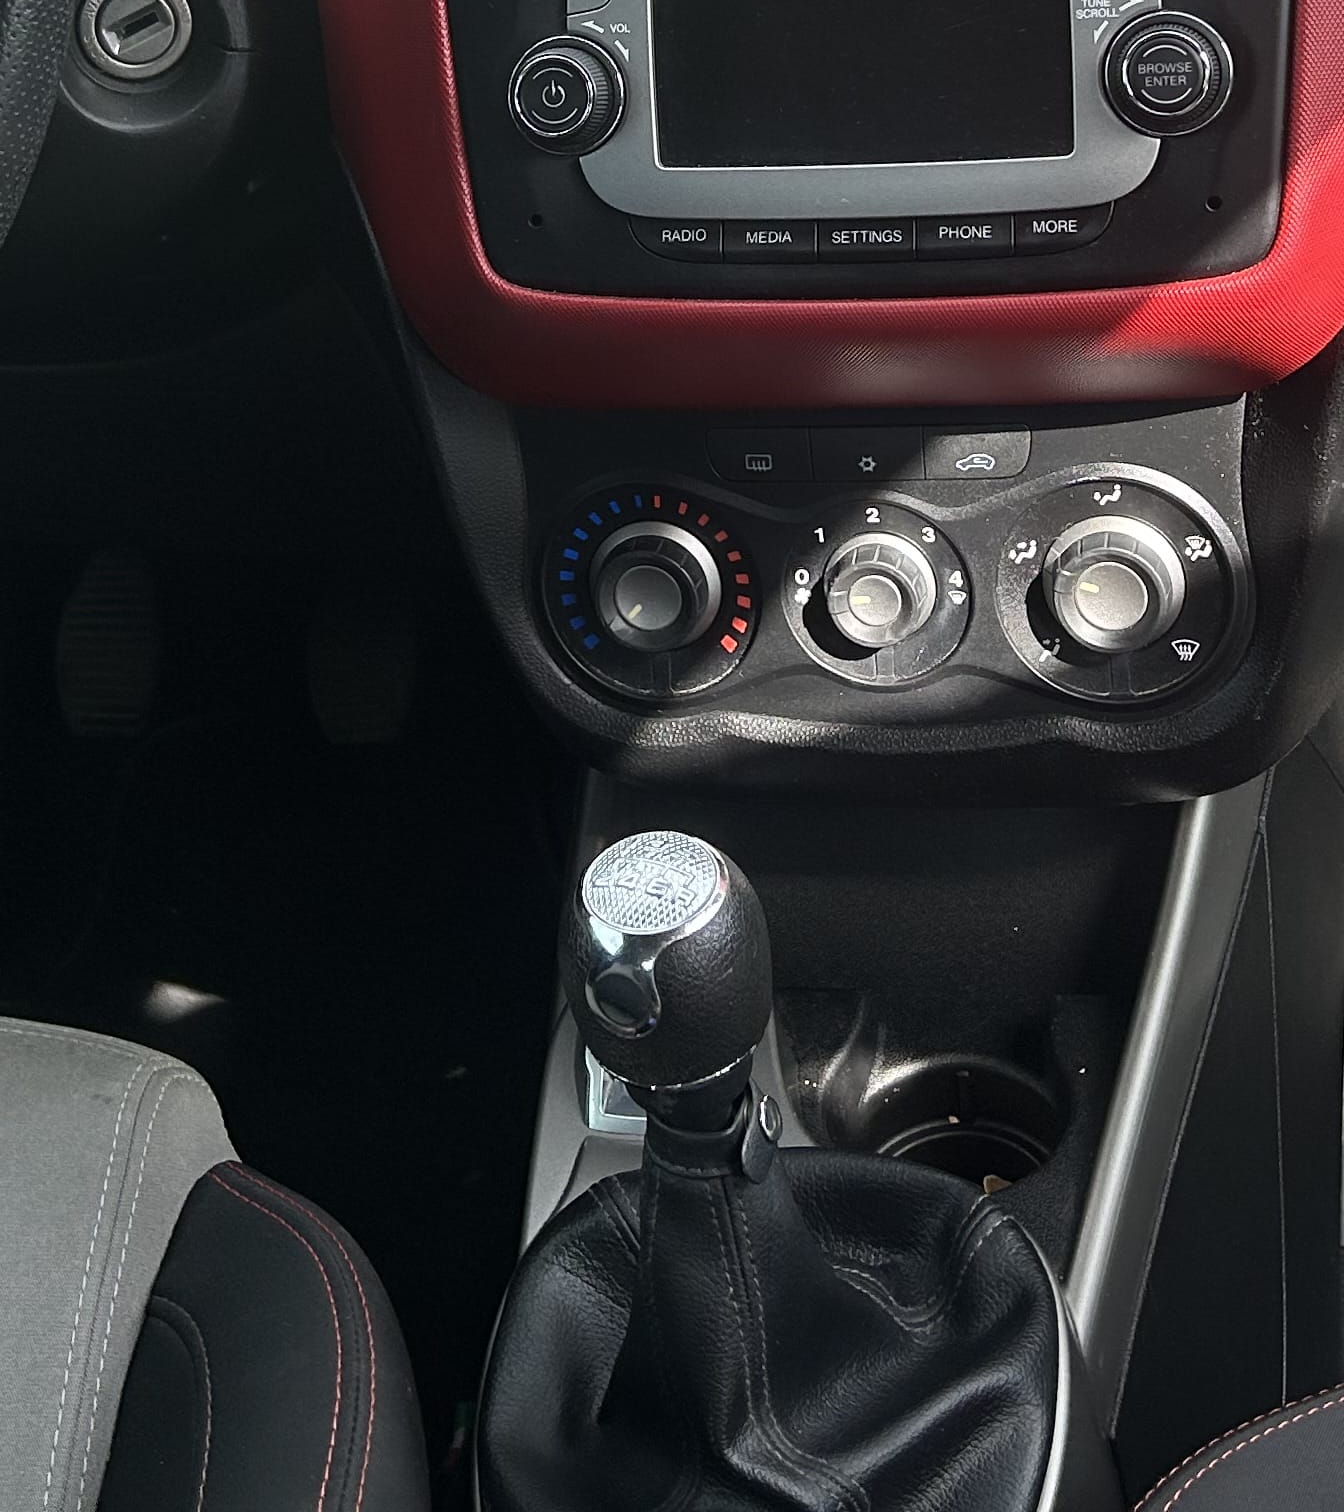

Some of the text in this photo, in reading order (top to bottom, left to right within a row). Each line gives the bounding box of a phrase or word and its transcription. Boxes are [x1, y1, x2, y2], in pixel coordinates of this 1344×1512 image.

[1075, 8, 1120, 20] SCROLL
[609, 23, 631, 34] VOL
[1137, 61, 1193, 75] BROWSE
[1145, 74, 1188, 88] ENTER
[661, 219, 1078, 245] RADIO MEDIA SETTINGS PHONE MORE
[864, 506, 881, 524] 2
[813, 526, 826, 544] 1
[921, 525, 937, 543] 3
[794, 567, 810, 585] 0
[948, 569, 964, 588] 4
